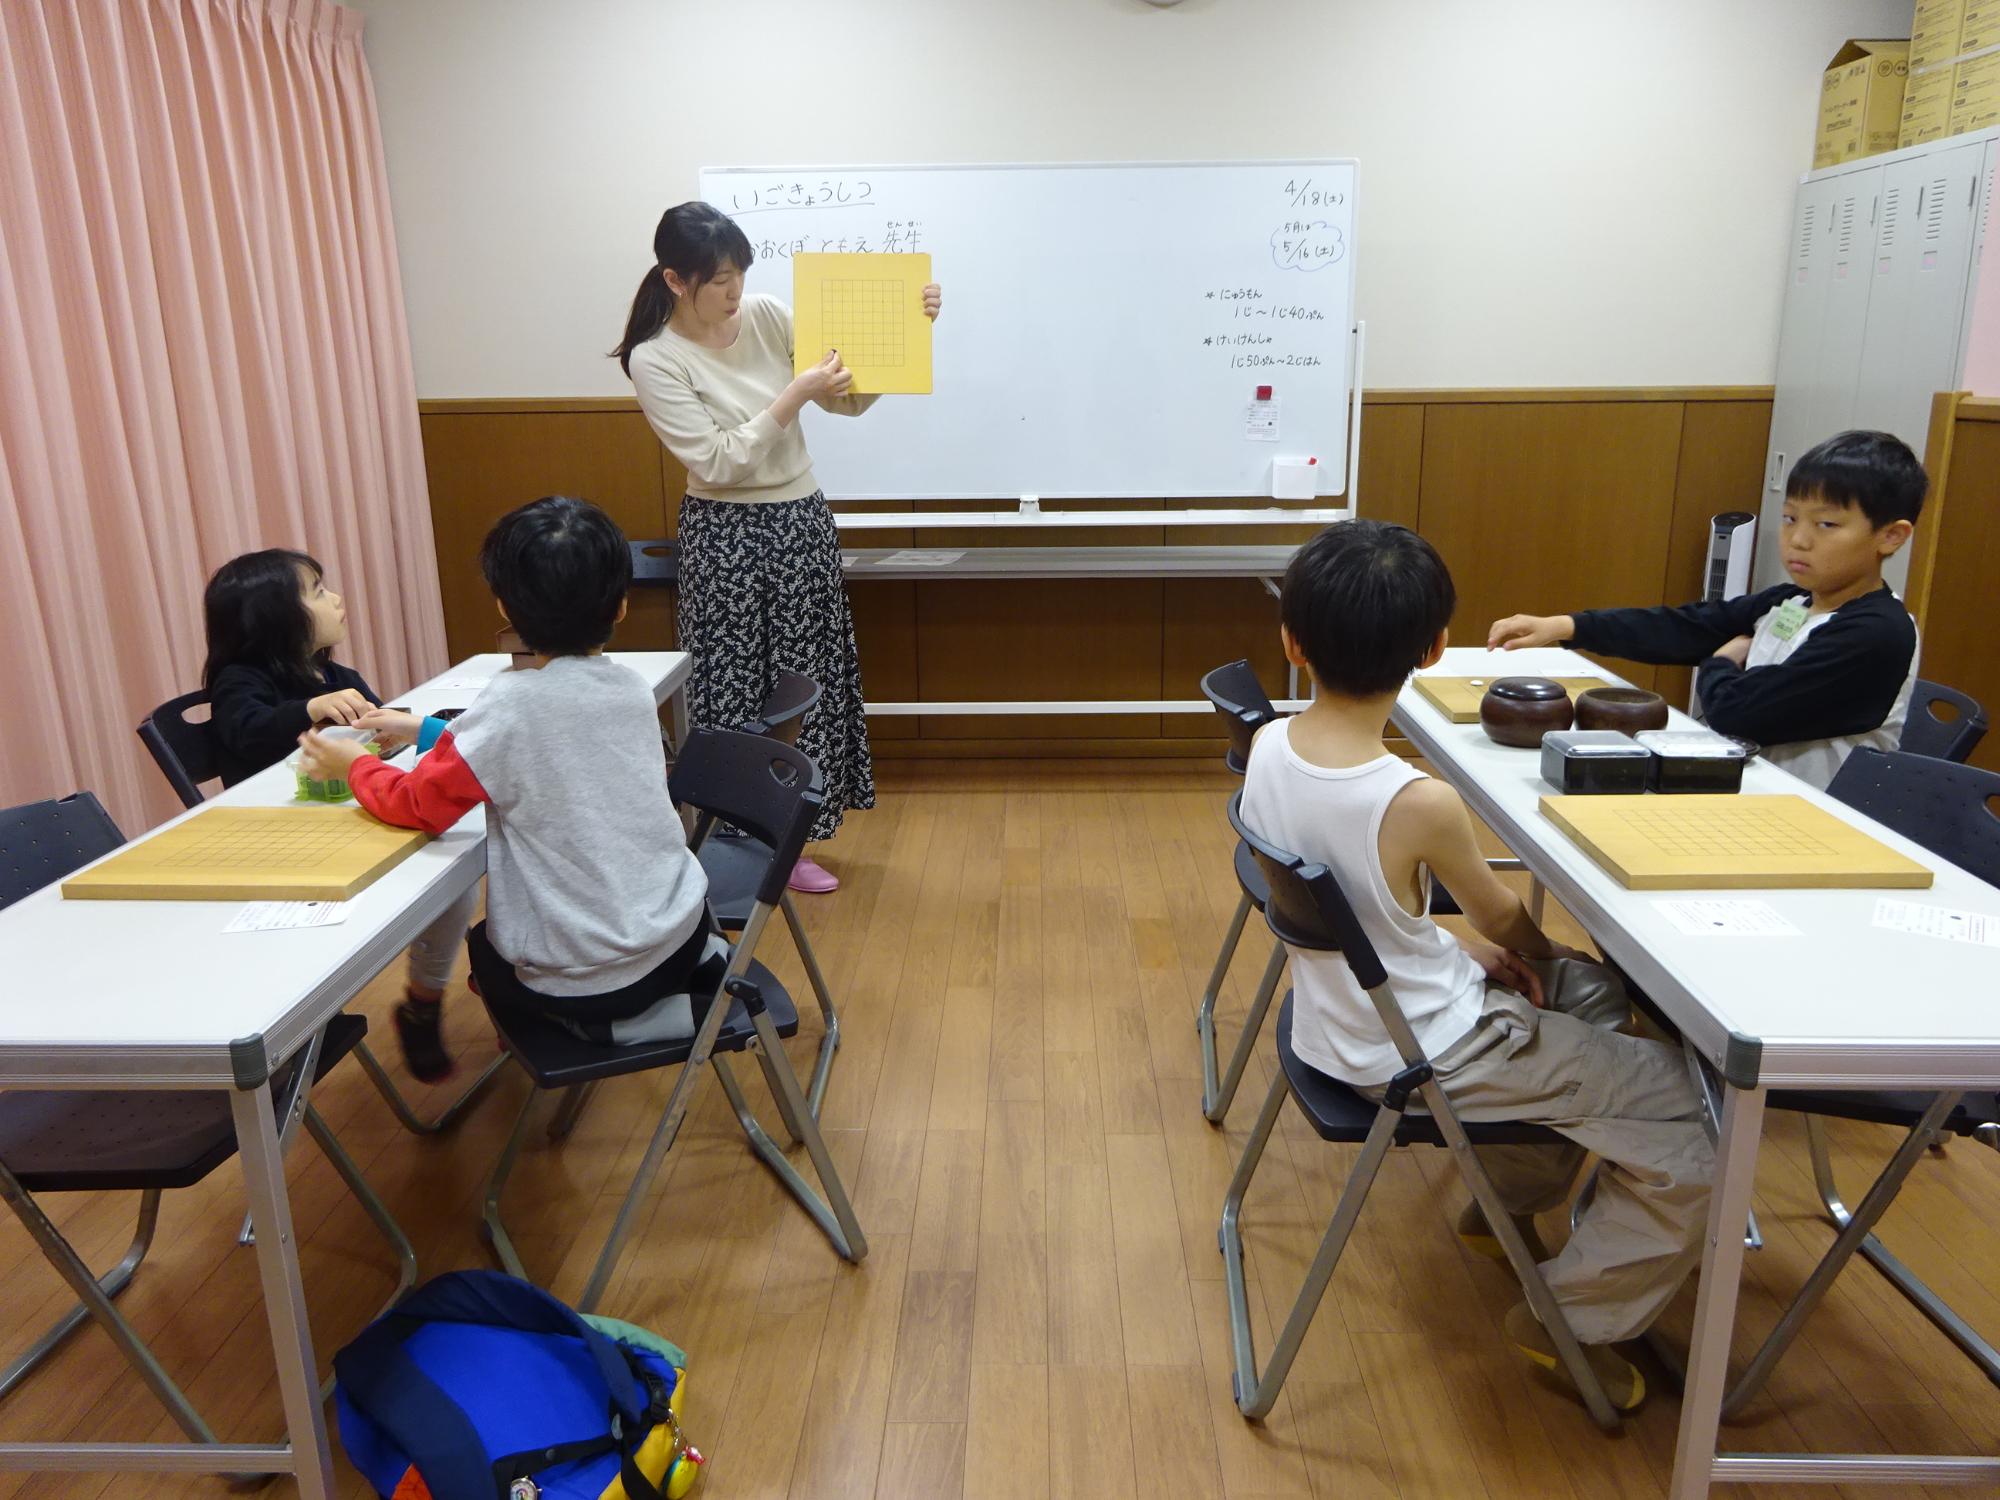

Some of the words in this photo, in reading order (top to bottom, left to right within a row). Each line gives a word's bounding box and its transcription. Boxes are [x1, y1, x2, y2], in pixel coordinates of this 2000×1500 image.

[733, 182, 872, 209] いごきょうしつ
[750, 235, 810, 260] おくぼ
[821, 236, 874, 254] ともえ
[883, 230, 922, 254] 先生
